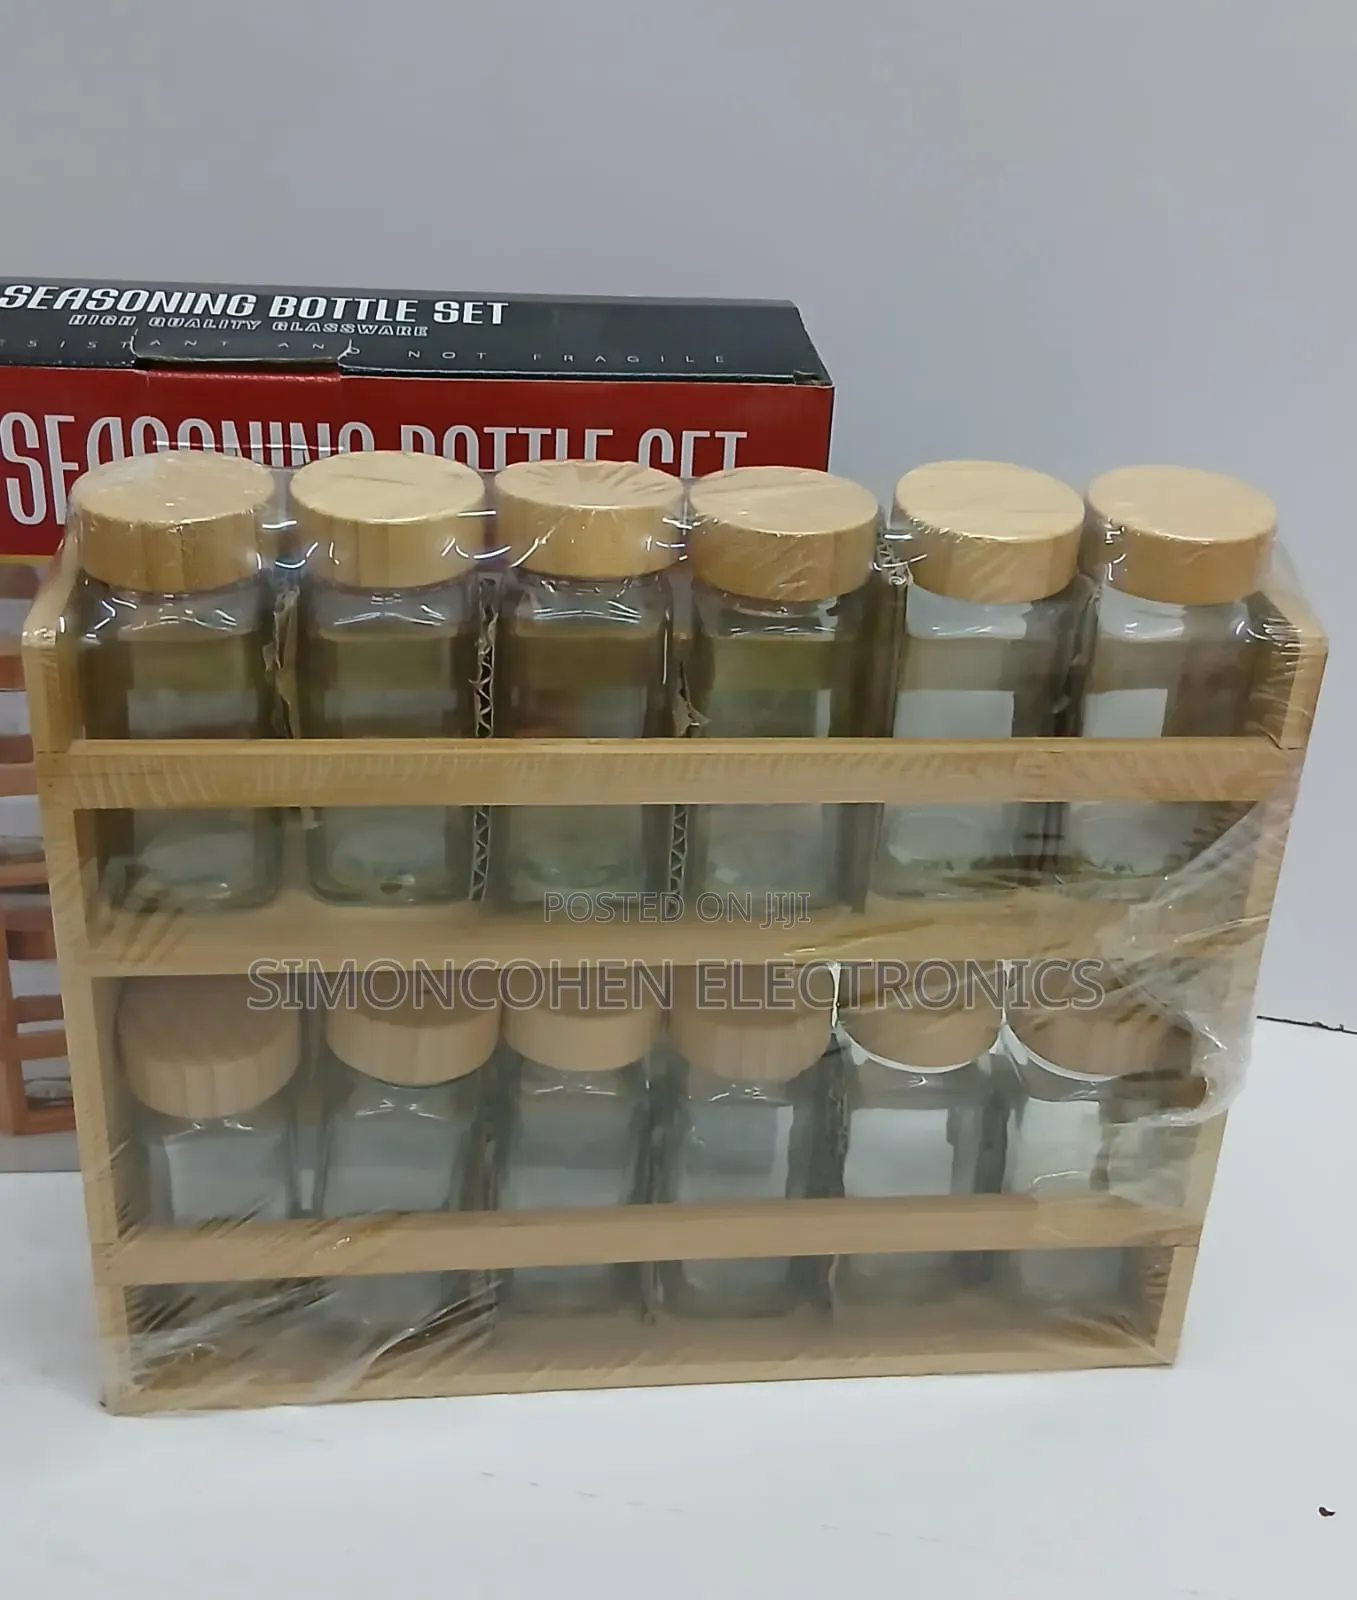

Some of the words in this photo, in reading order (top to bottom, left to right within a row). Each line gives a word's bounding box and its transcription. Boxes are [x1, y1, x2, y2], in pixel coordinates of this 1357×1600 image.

[0, 284, 257, 317] SEASONING
[268, 295, 418, 323] BOTTLE
[433, 299, 508, 325] SET
[68, 314, 137, 326] HIGH
[148, 316, 262, 332] QUALITY
[271, 321, 428, 337] GLASSWARE
[408, 350, 487, 360] NOT
[533, 353, 726, 364] FRAGILE
